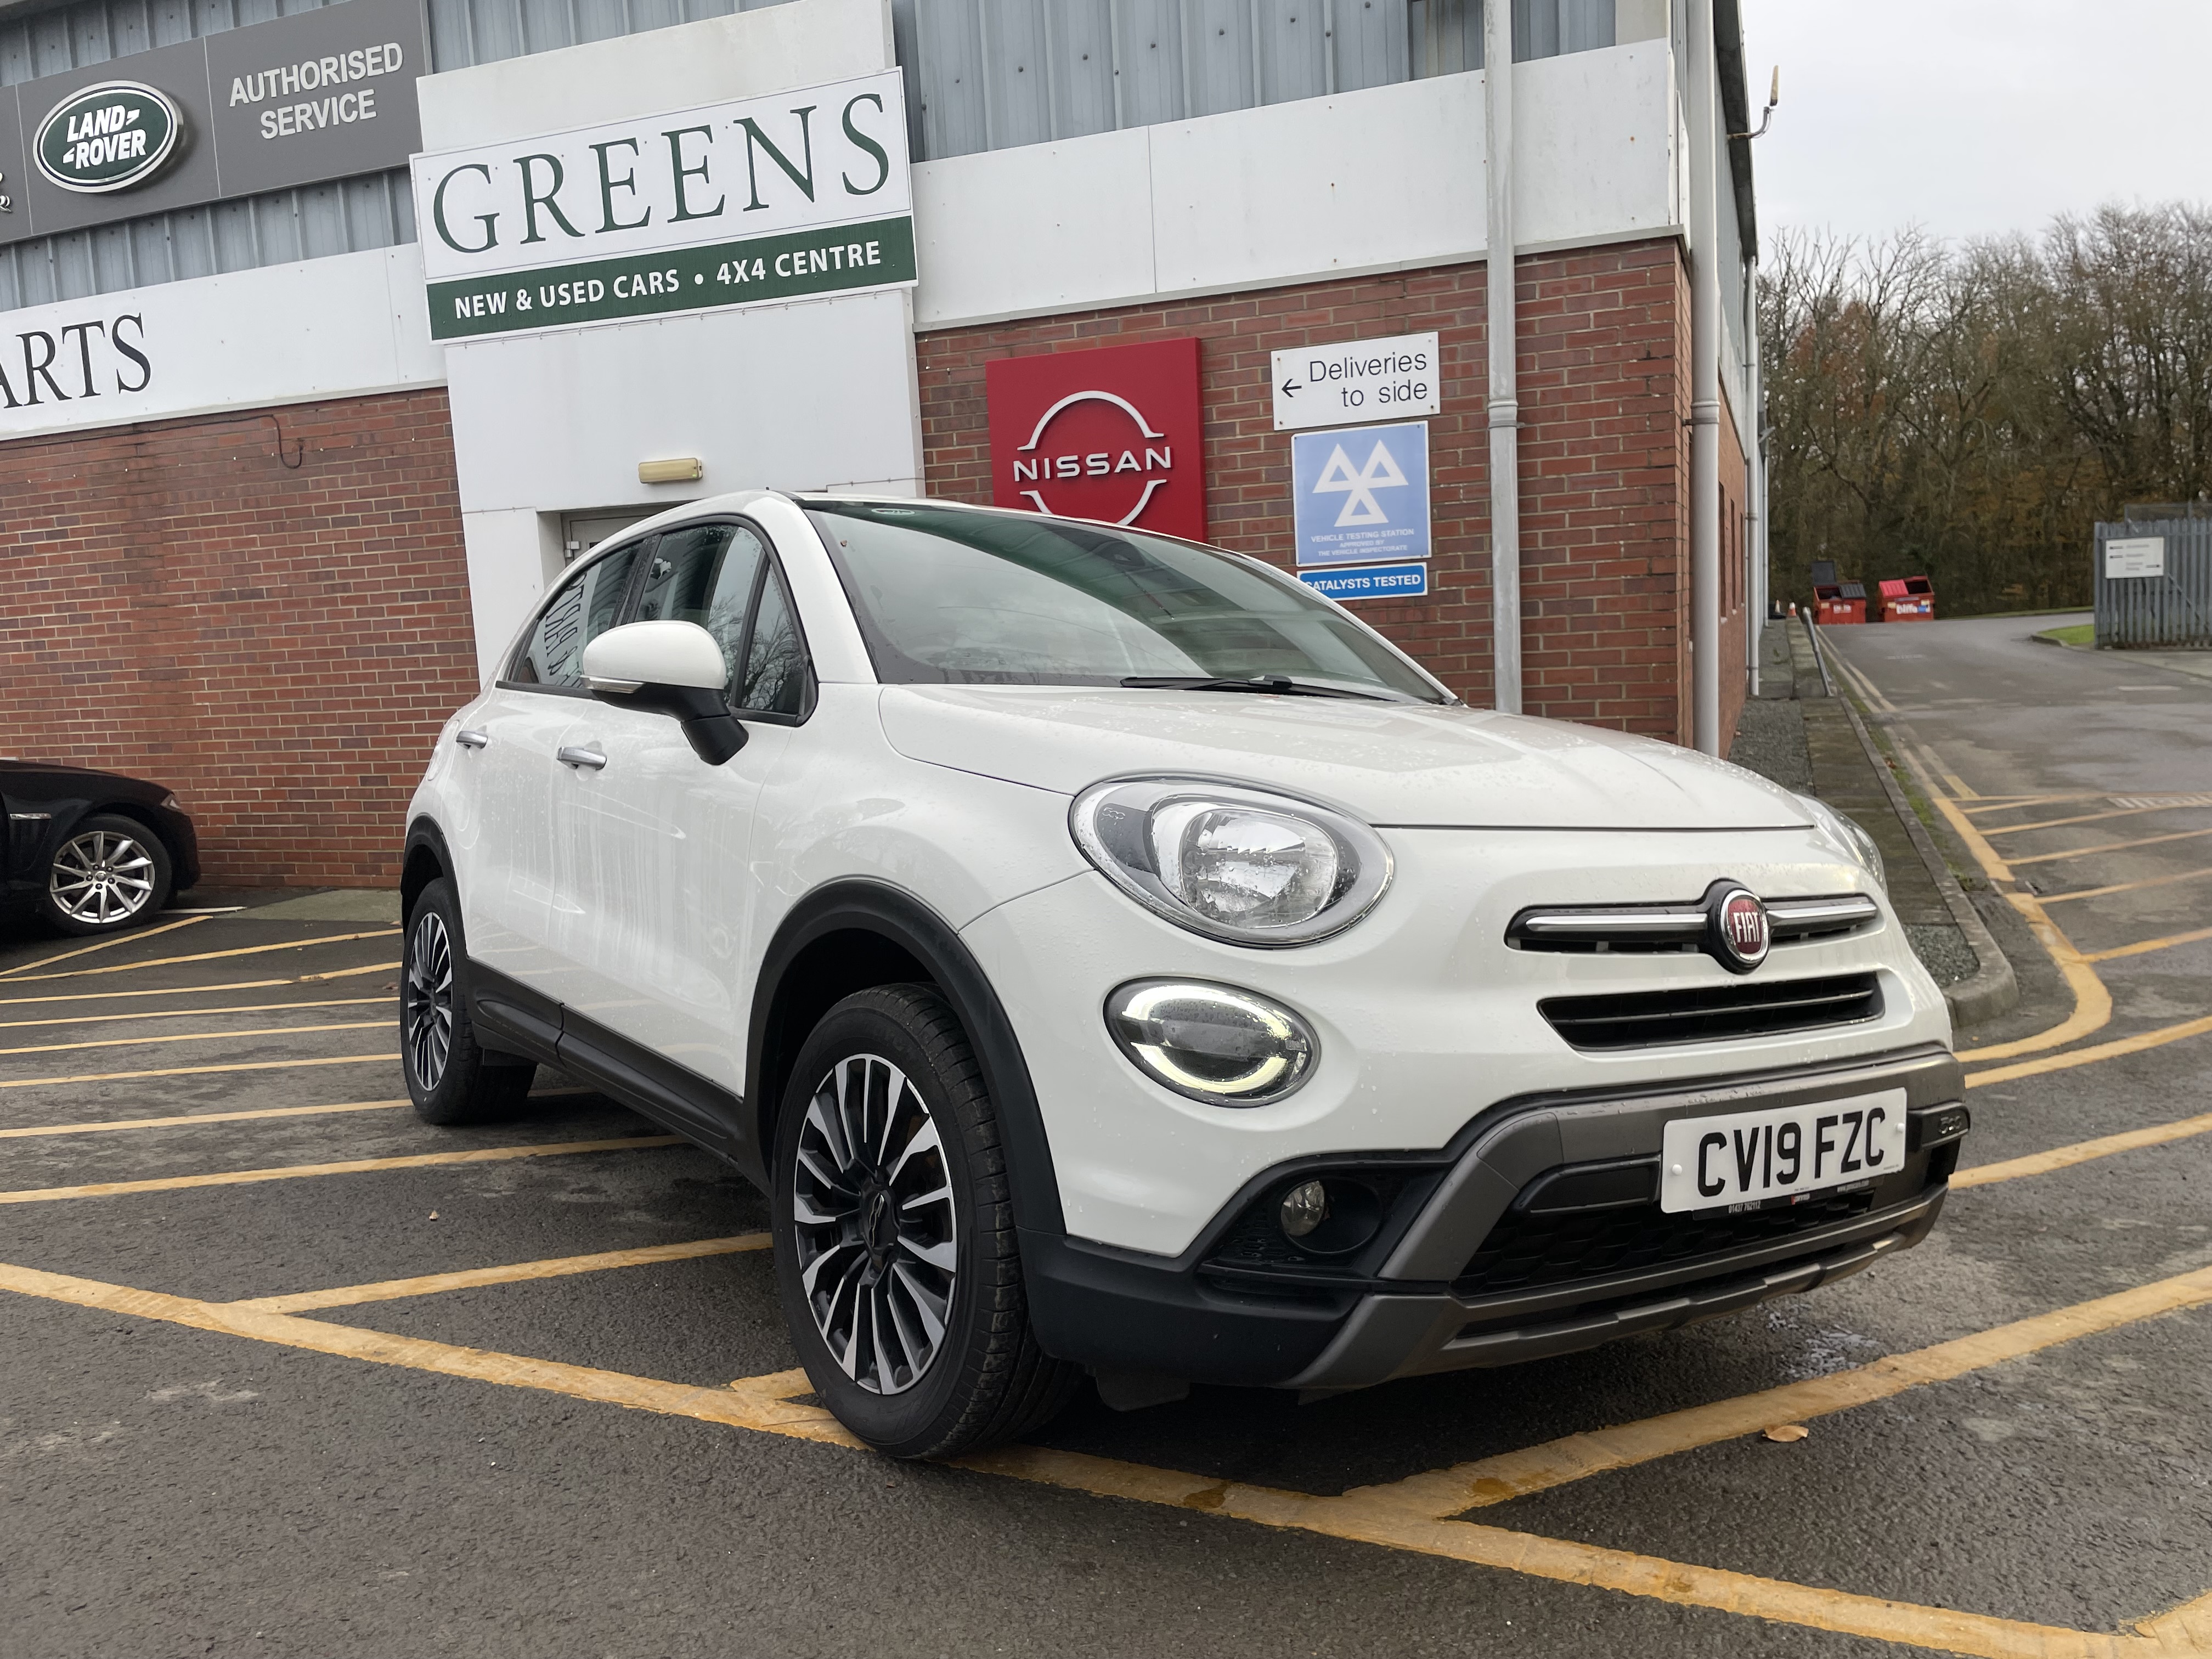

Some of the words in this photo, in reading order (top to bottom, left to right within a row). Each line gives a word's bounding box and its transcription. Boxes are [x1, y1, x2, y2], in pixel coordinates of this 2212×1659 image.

[229, 42, 403, 107] AUTHORISED
[67, 105, 125, 143] LAND
[260, 89, 377, 139] SERVICE
[75, 129, 146, 169] ROVER
[433, 93, 890, 254] GREENS
[454, 291, 507, 319] NEW
[516, 290, 532, 311] &
[540, 279, 605, 308] USED
[613, 269, 680, 299] CARS
[716, 258, 766, 285] 4X4
[775, 241, 882, 278] CENTRE
[1310, 352, 1427, 382] Deliveries
[1341, 387, 1364, 407] to
[1379, 379, 1427, 403] side
[1013, 446, 1171, 482] NISSAN
[1311, 534, 1344, 543] VEHICLE
[1346, 531, 1379, 540] TESTING
[1381, 528, 1414, 538] STATION
[1373, 574, 1421, 588] TESTED
[1733, 911, 1760, 943] FIAT
[1697, 1121, 1801, 1198] CV19
[1814, 1107, 1885, 1180] FZC
